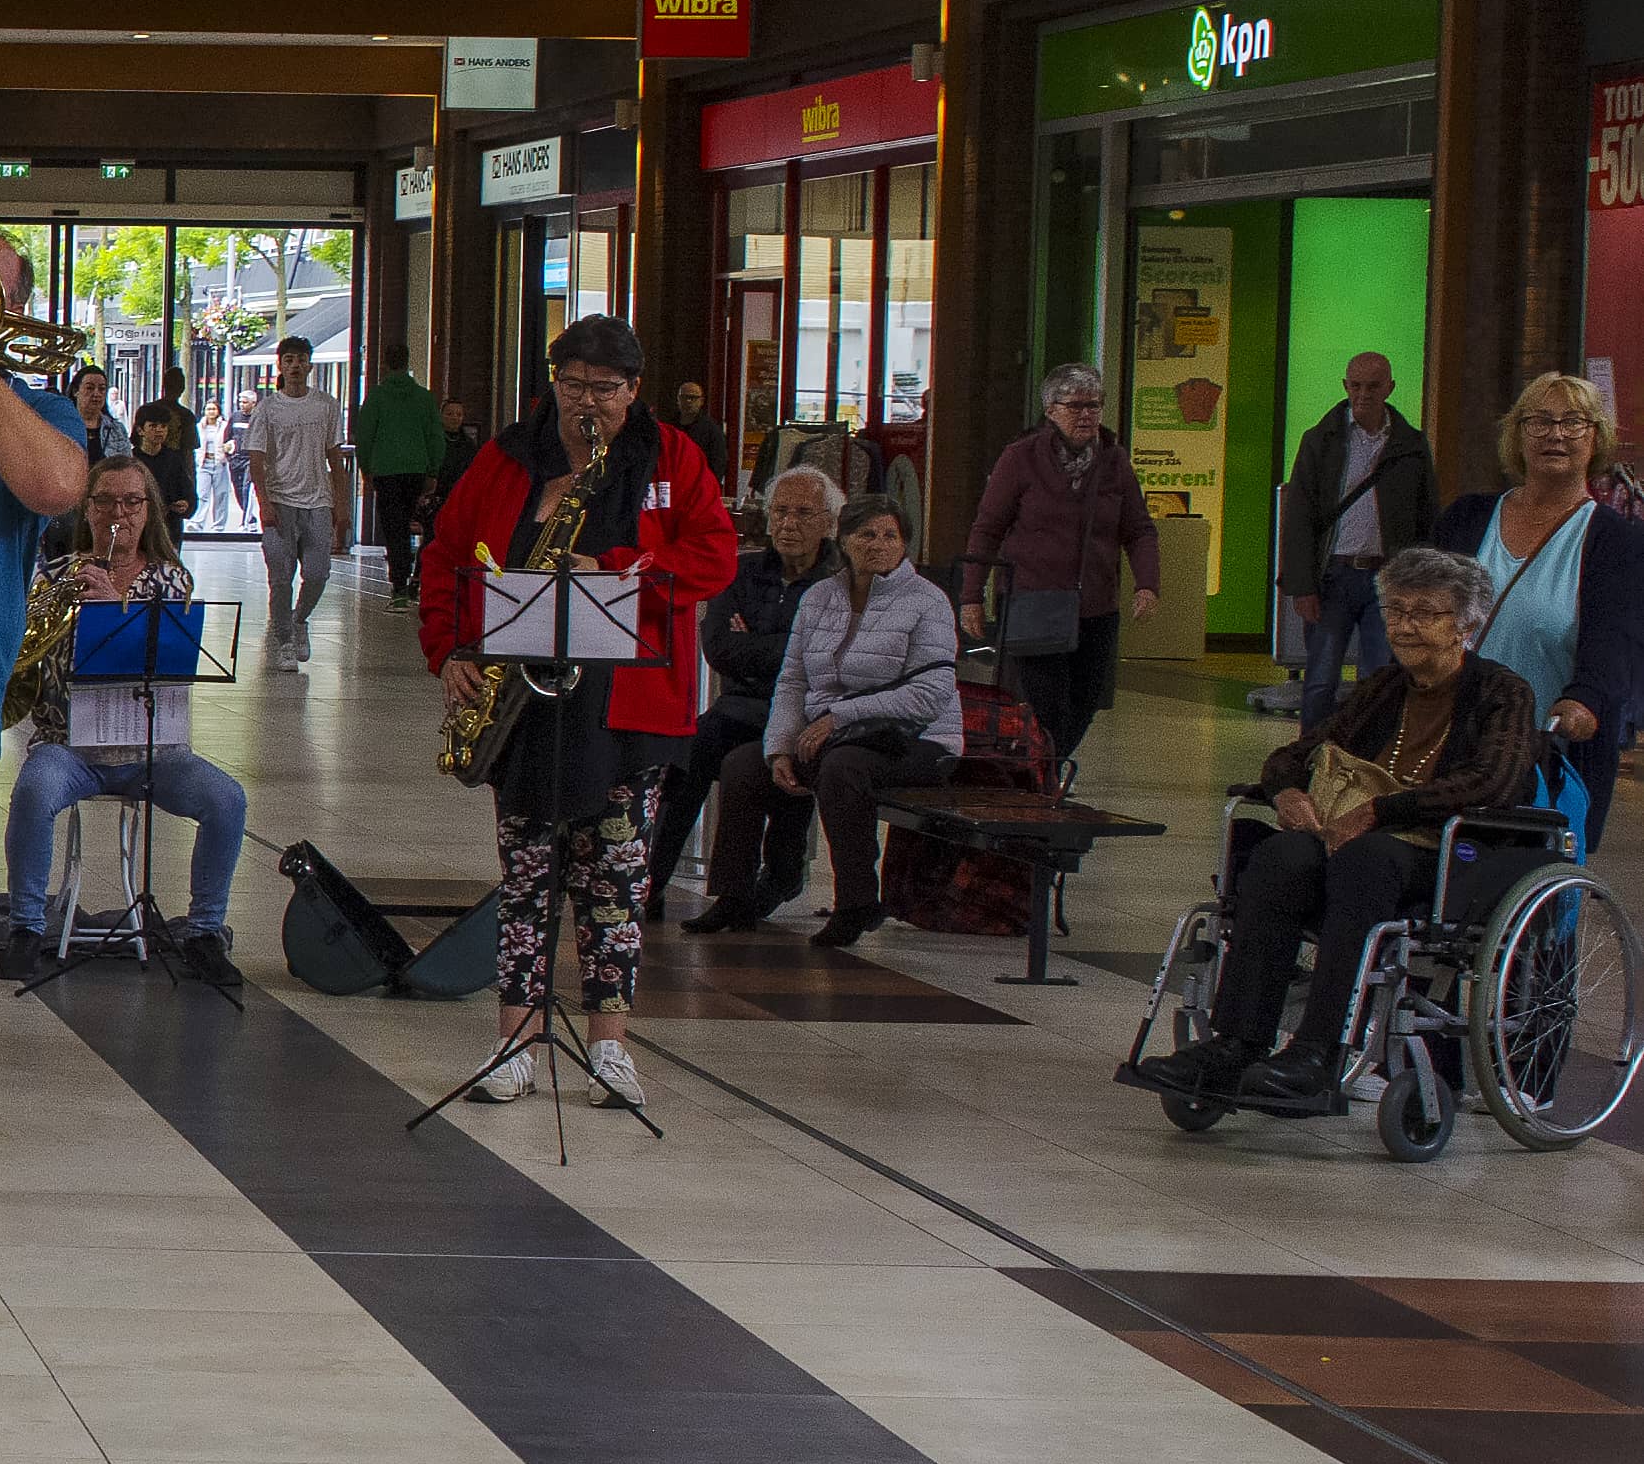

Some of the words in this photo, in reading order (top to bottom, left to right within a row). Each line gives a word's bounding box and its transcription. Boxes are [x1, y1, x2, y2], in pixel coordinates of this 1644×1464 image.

[1220, 13, 1272, 77] kpn
[468, 57, 493, 67] HANS
[495, 58, 531, 67] ANDERS
[801, 95, 840, 134] wibra
[502, 149, 522, 177] HANS
[522, 144, 550, 175] ANDERS
[1133, 458, 1164, 467] Galaxy
[1134, 448, 1175, 457] Samsung
